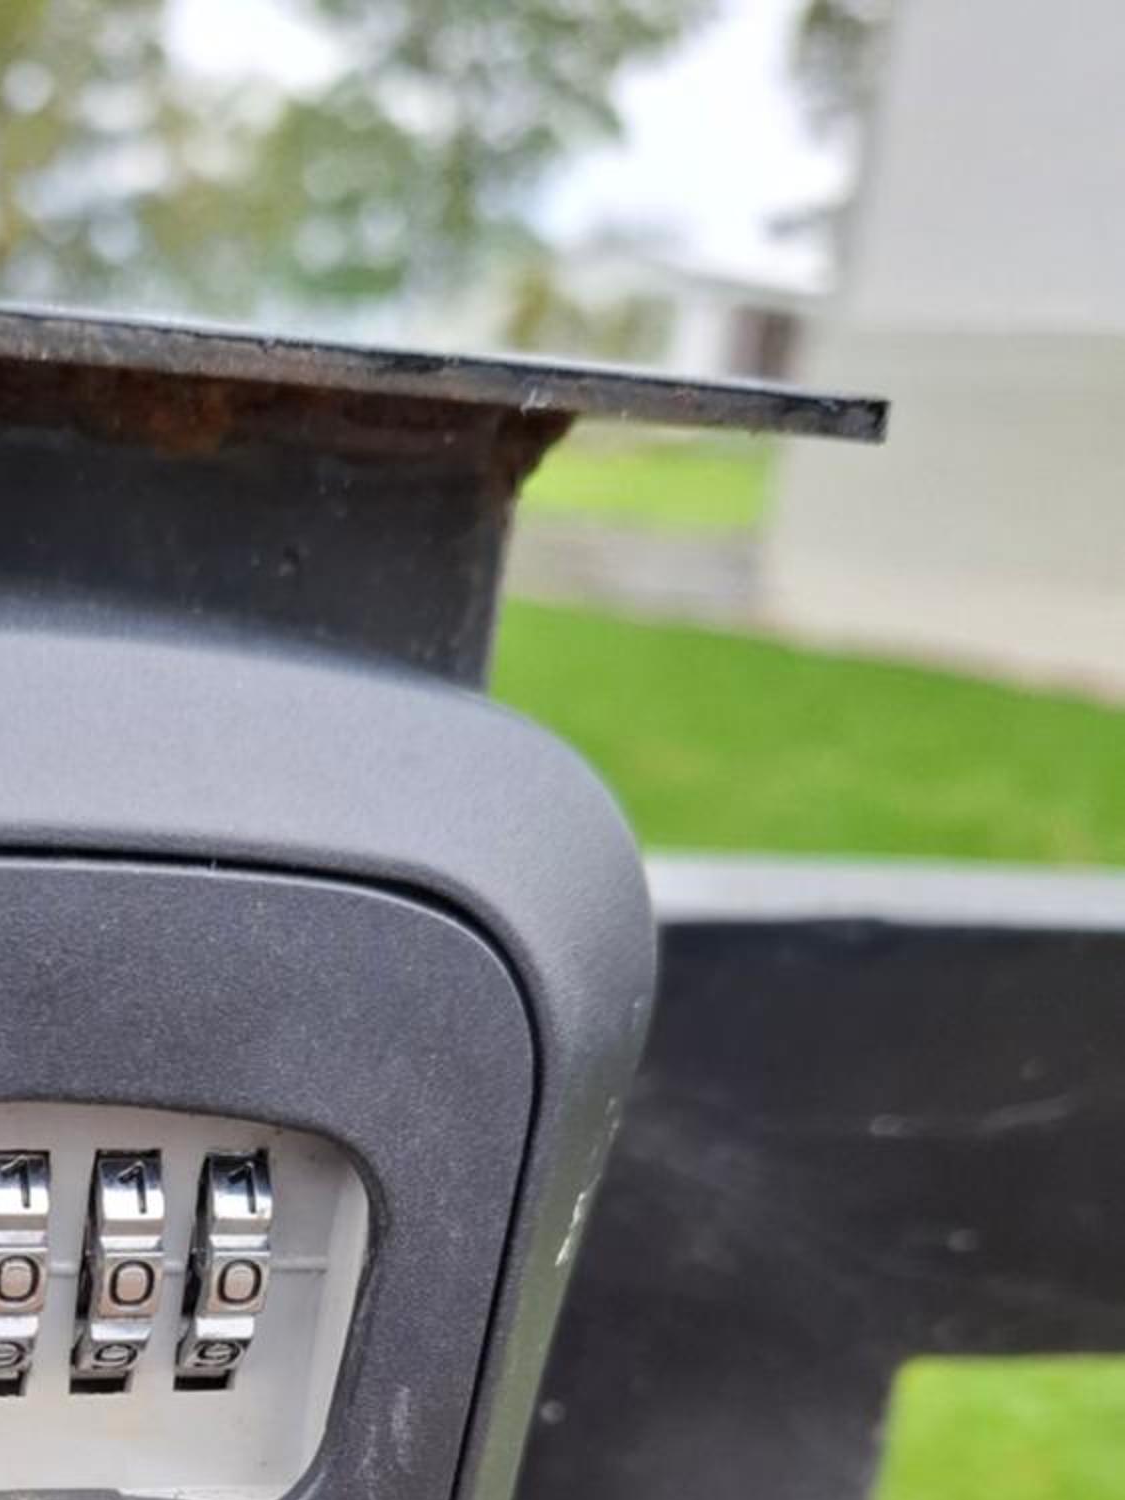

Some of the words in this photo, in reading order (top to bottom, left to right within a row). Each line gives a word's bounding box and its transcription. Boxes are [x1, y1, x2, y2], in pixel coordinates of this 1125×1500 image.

[0, 1154, 31, 1209] 1
[116, 1160, 148, 1214] 1
[227, 1160, 257, 1214] 1
[108, 1258, 156, 1306] 0
[216, 1257, 263, 1305] 0
